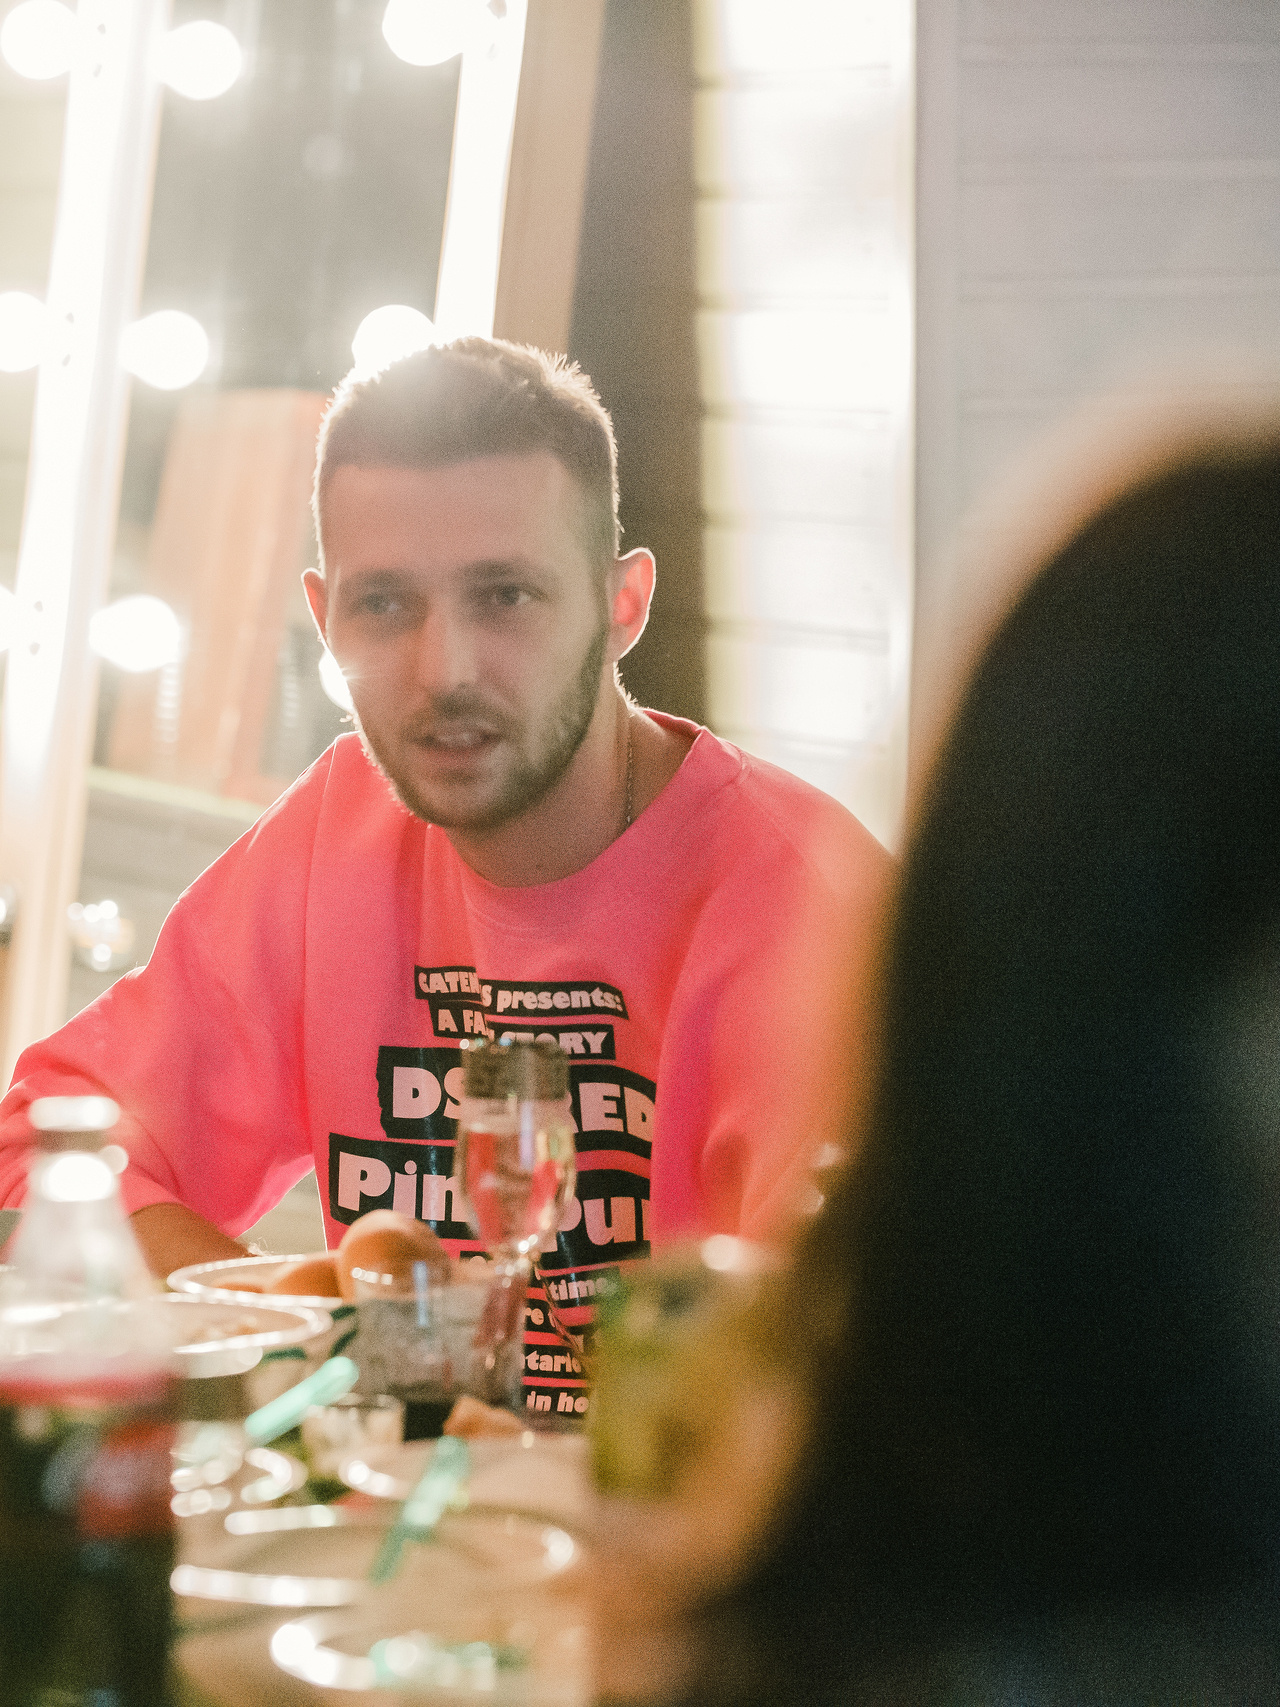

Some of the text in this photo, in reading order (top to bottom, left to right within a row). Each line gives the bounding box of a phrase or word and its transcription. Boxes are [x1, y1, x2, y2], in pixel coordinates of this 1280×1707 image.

[438, 1009, 458, 1032] A
[338, 1151, 470, 1222] Pin
[557, 1392, 589, 1413] ho
